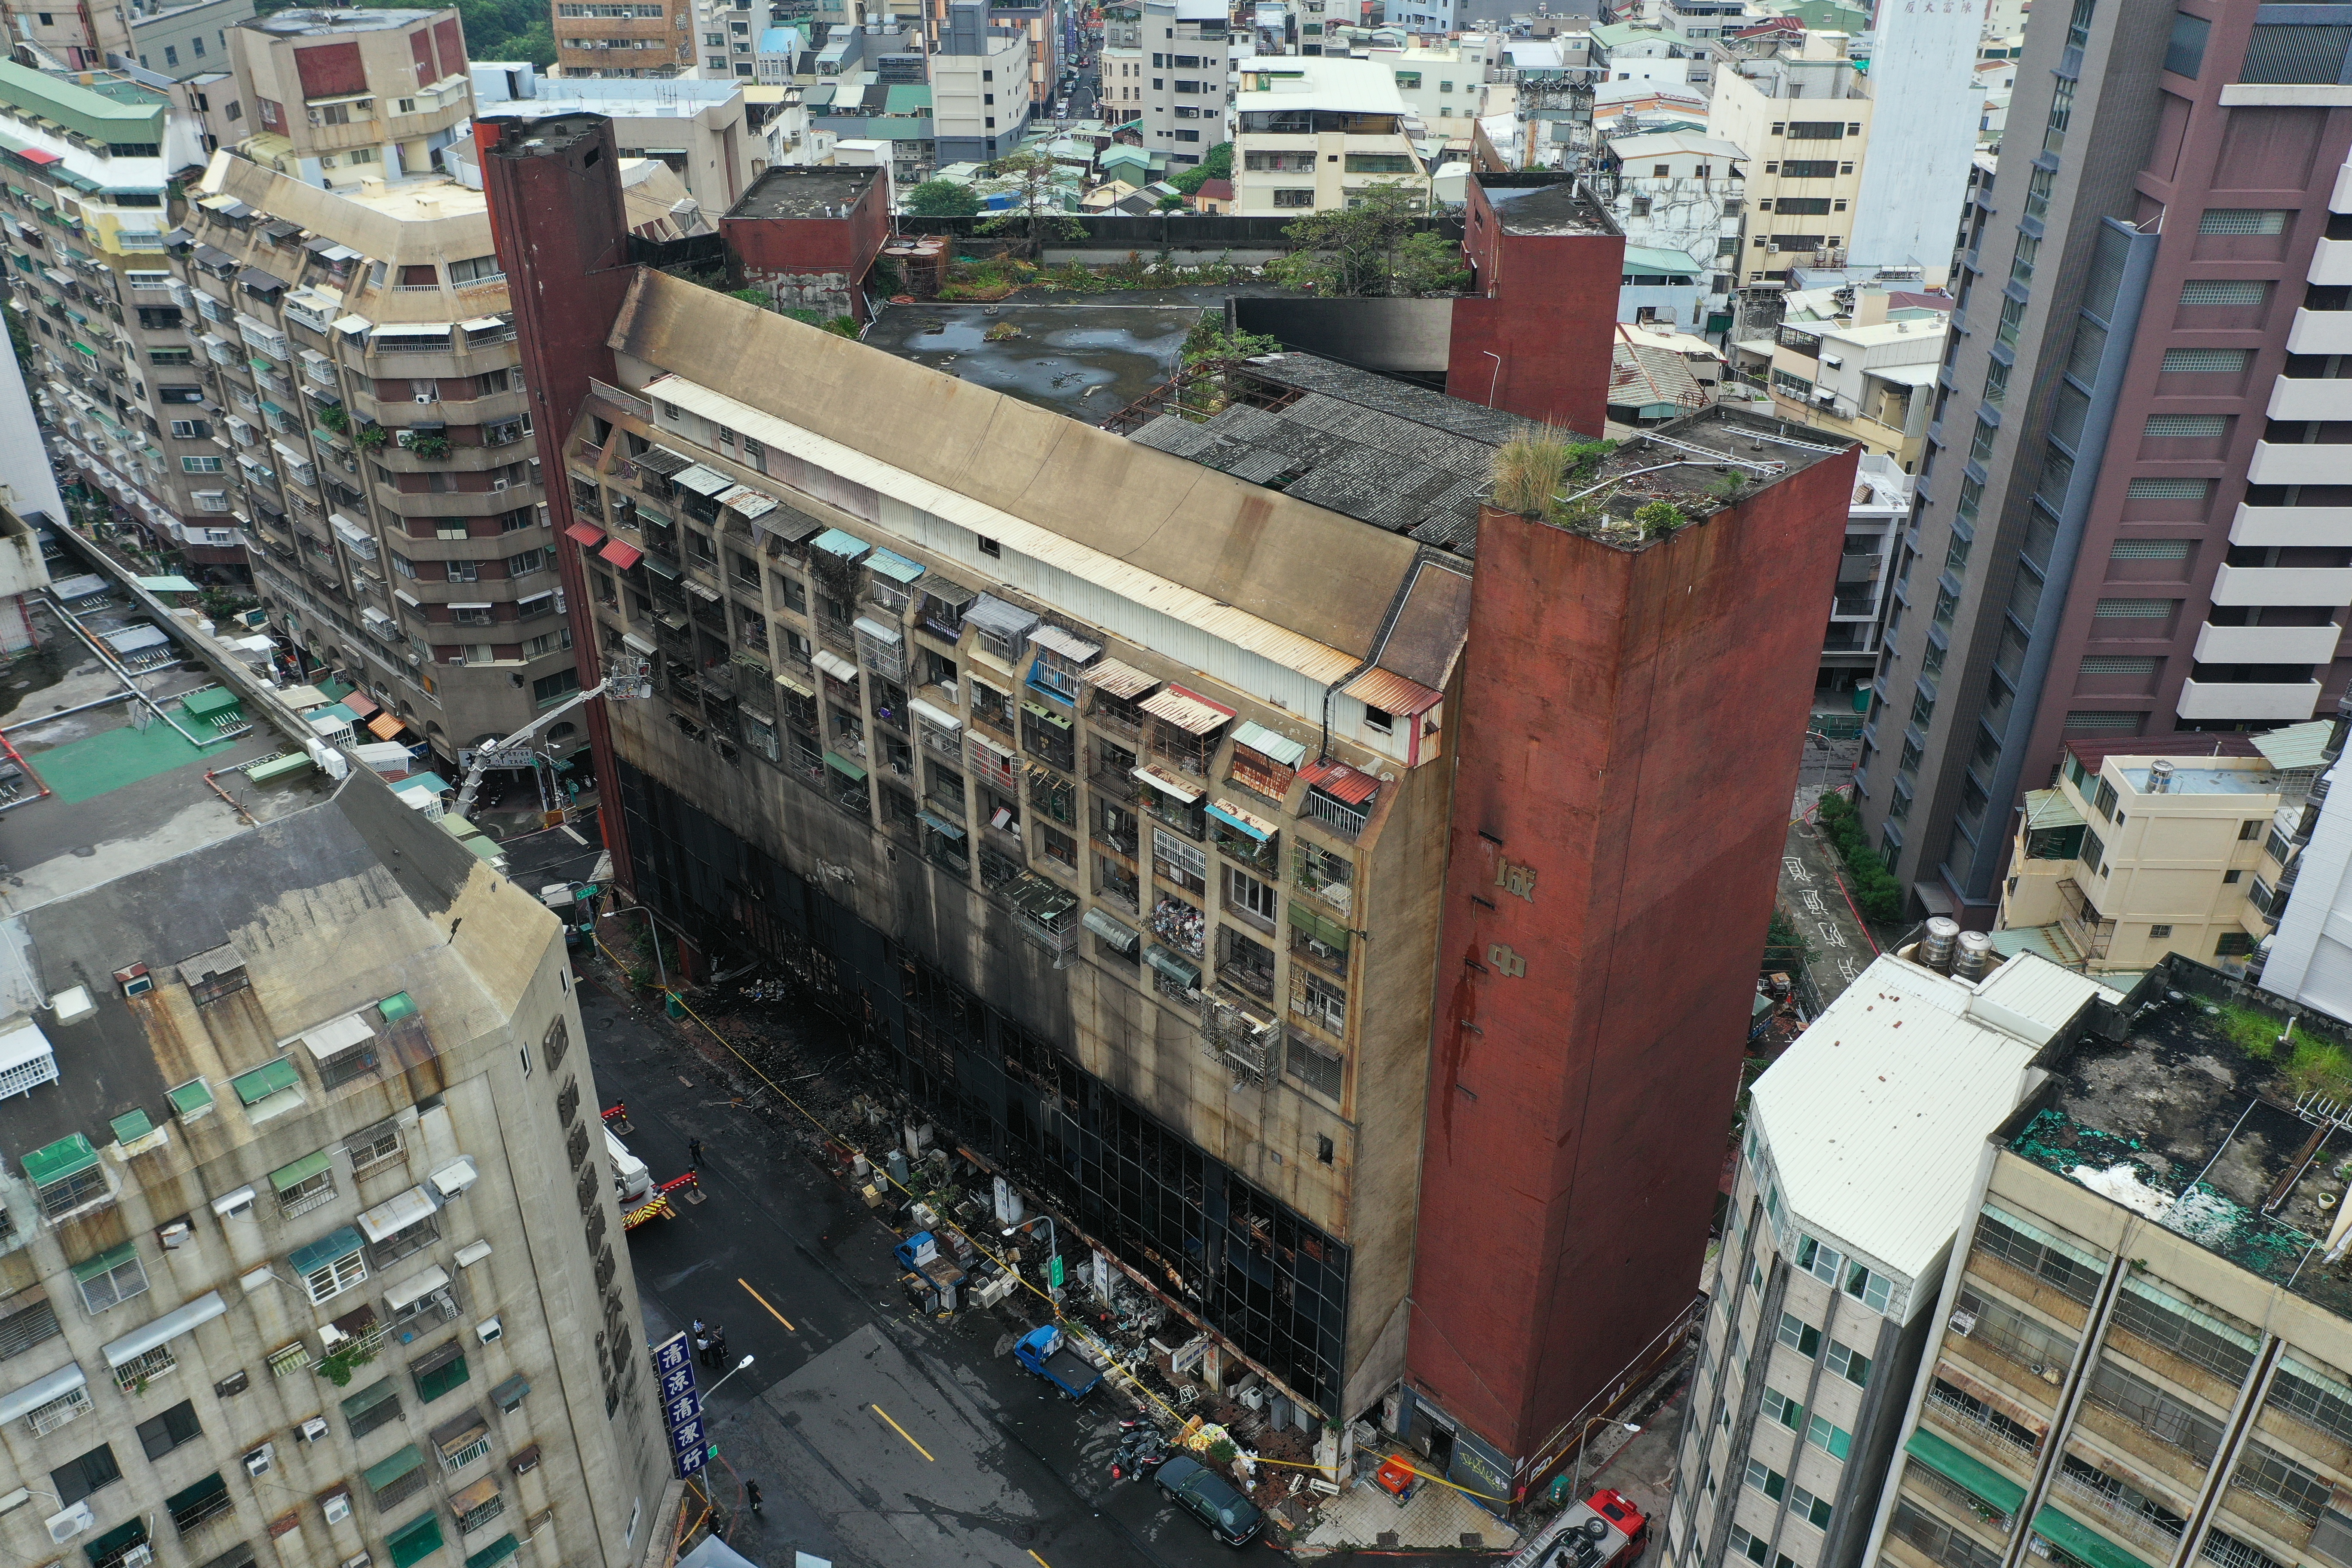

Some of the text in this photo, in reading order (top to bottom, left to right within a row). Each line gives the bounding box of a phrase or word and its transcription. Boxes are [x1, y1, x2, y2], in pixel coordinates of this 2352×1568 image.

[662, 1343, 702, 1472] 清涼清潔行
